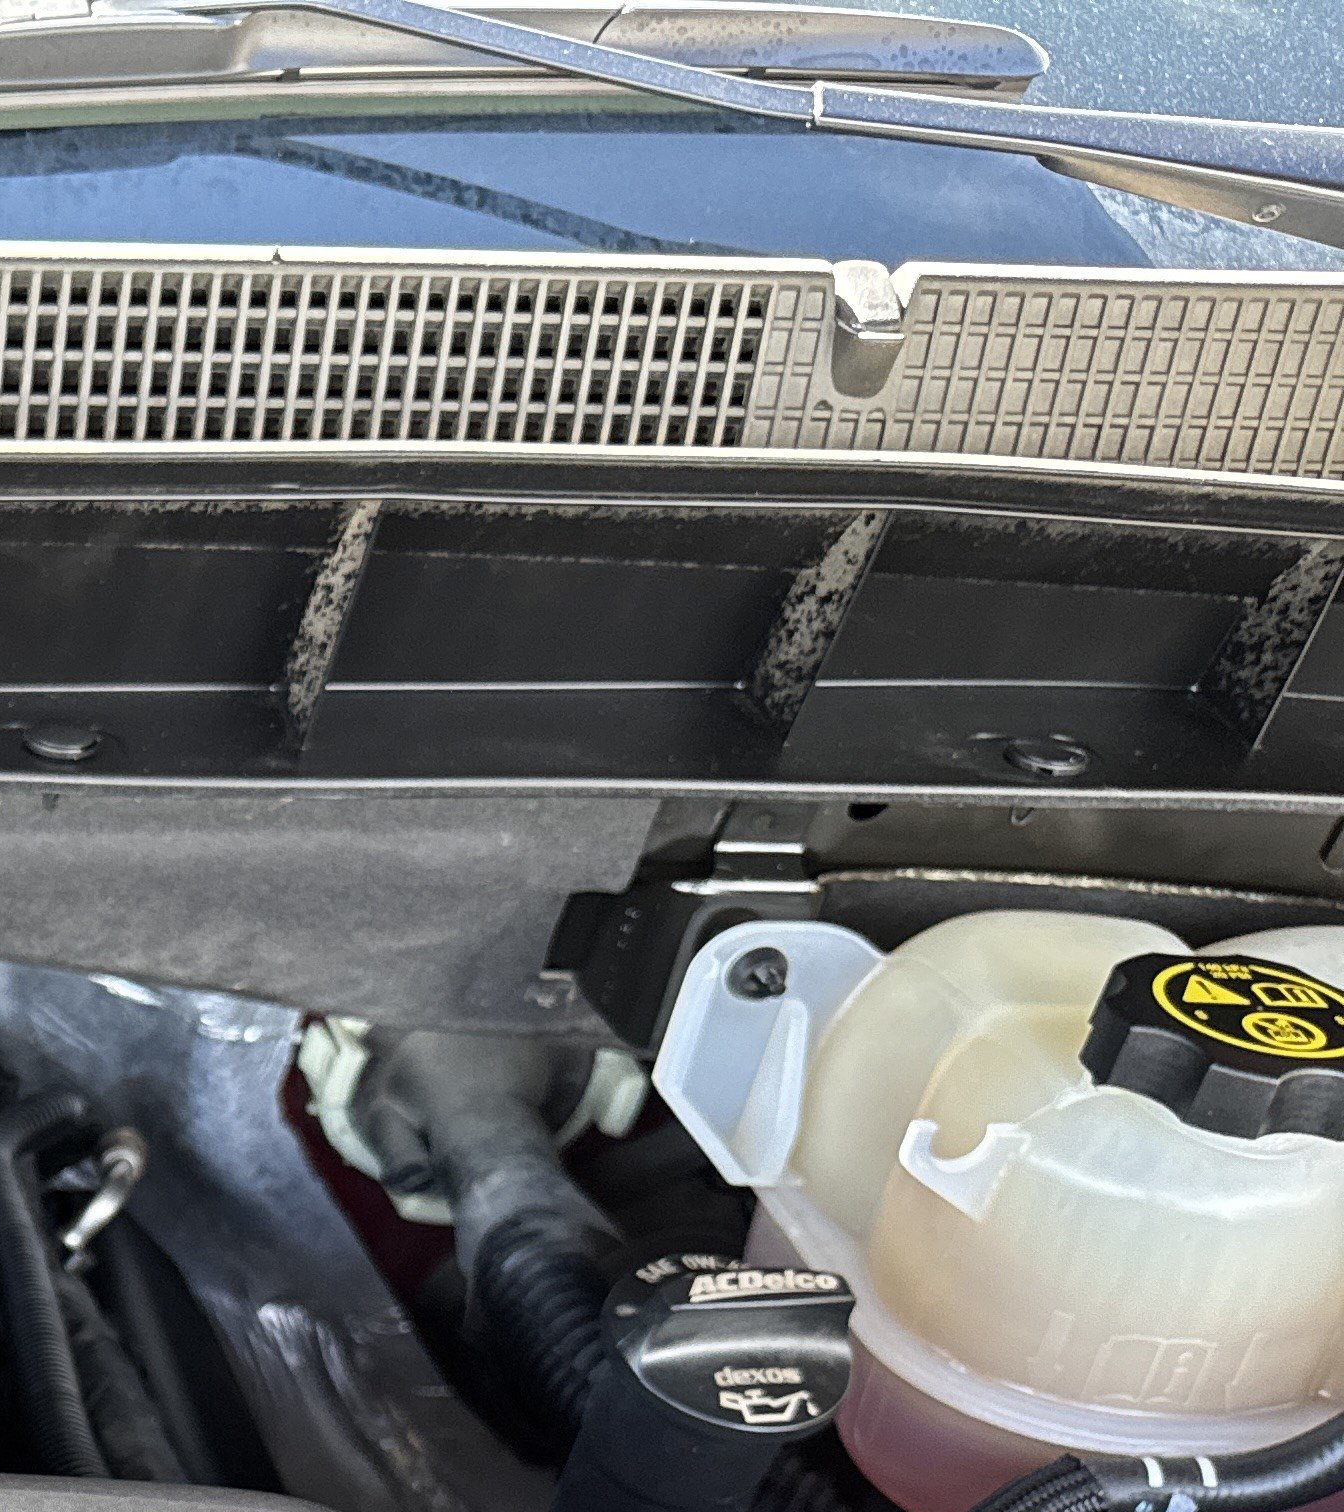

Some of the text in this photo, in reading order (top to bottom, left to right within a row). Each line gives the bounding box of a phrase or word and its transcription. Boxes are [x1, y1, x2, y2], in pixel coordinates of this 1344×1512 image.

[636, 1258, 676, 1284] SAE
[688, 1268, 839, 1298] ACDelco
[714, 1366, 802, 1387] dexos
